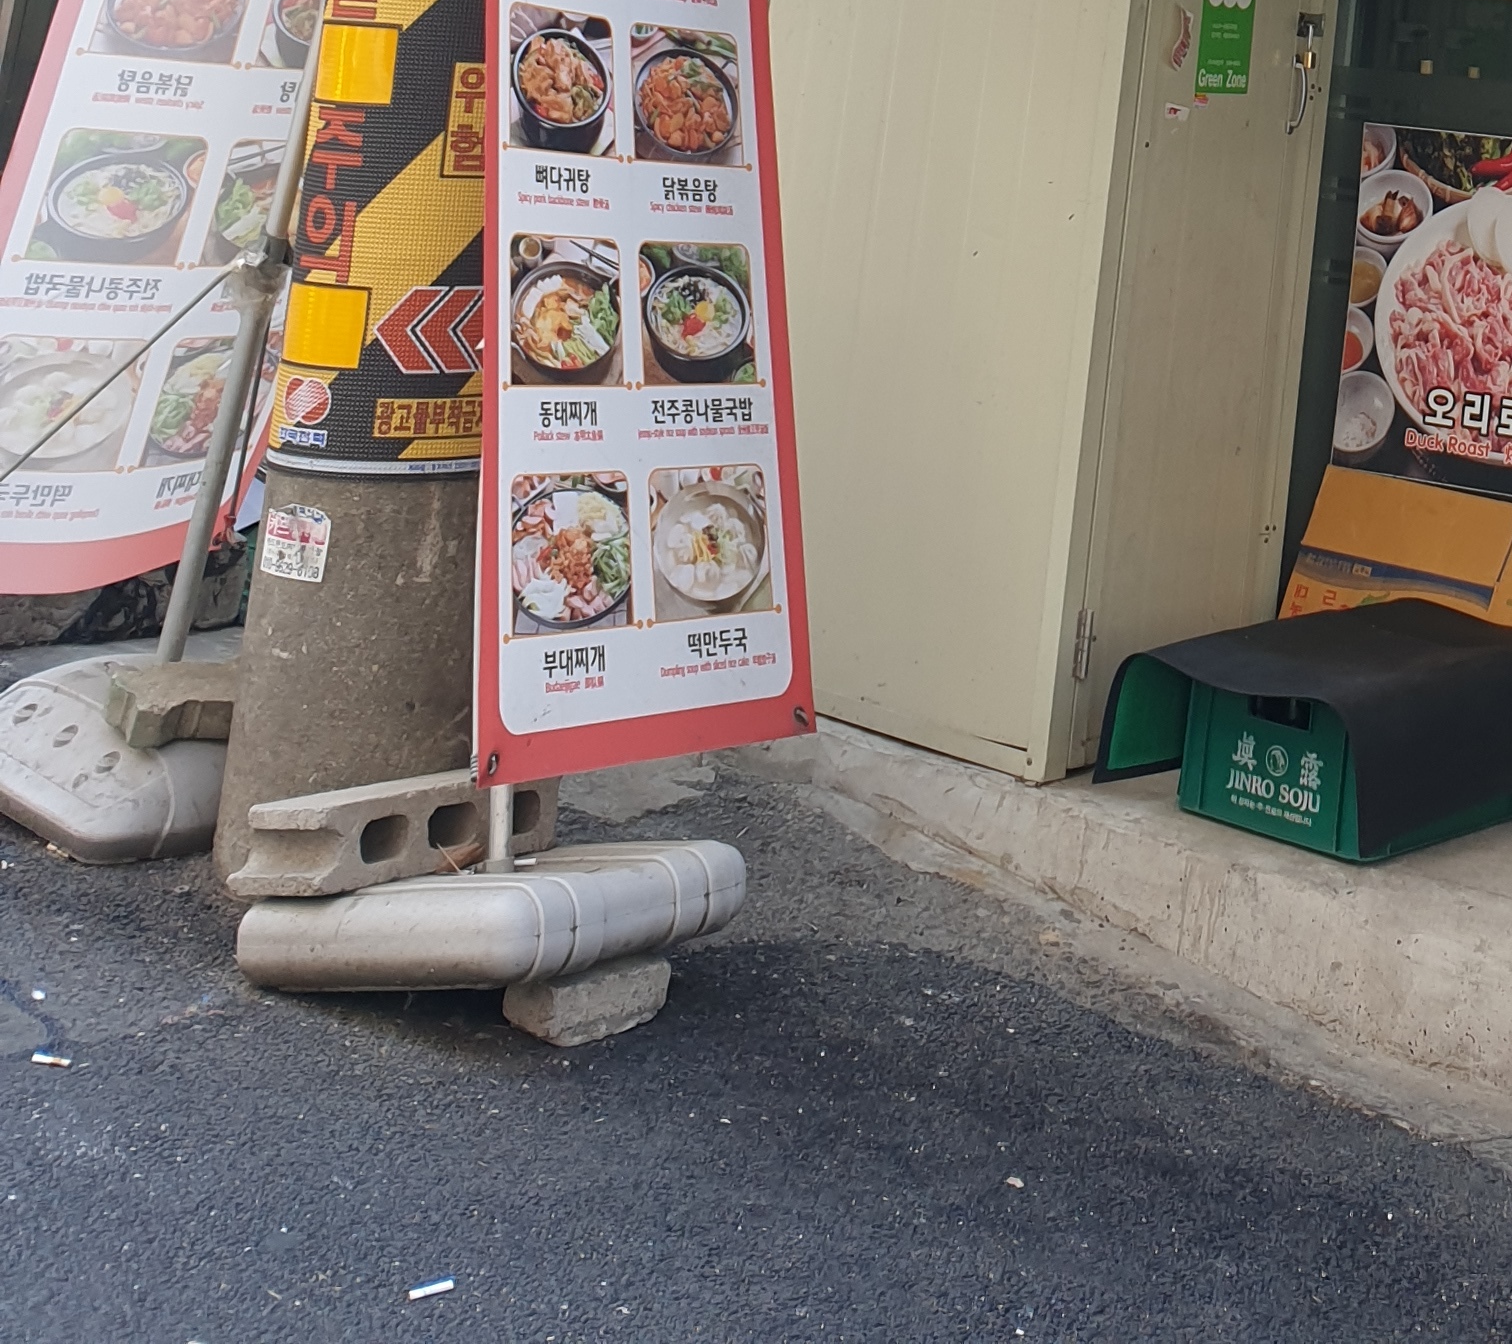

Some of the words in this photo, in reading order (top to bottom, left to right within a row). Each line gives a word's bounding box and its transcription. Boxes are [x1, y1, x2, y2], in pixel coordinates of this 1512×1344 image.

[1198, 68, 1223, 88] Green
[1226, 69, 1247, 89] Zone
[535, 164, 592, 194] 뼈다귀탕
[662, 176, 719, 204] 닭볶음탕
[300, 107, 366, 284] 주의
[377, 400, 483, 435] 광고물부착금
[538, 400, 598, 428] 동태찌개
[650, 397, 754, 425] 전주콩나물국밥
[1404, 428, 1444, 451] Duck
[1447, 435, 1491, 459] Roast
[687, 627, 748, 658] 떡만두국
[542, 645, 606, 679] 부대찌개
[1226, 768, 1275, 799] JINRO
[1279, 783, 1320, 813] SOJU
